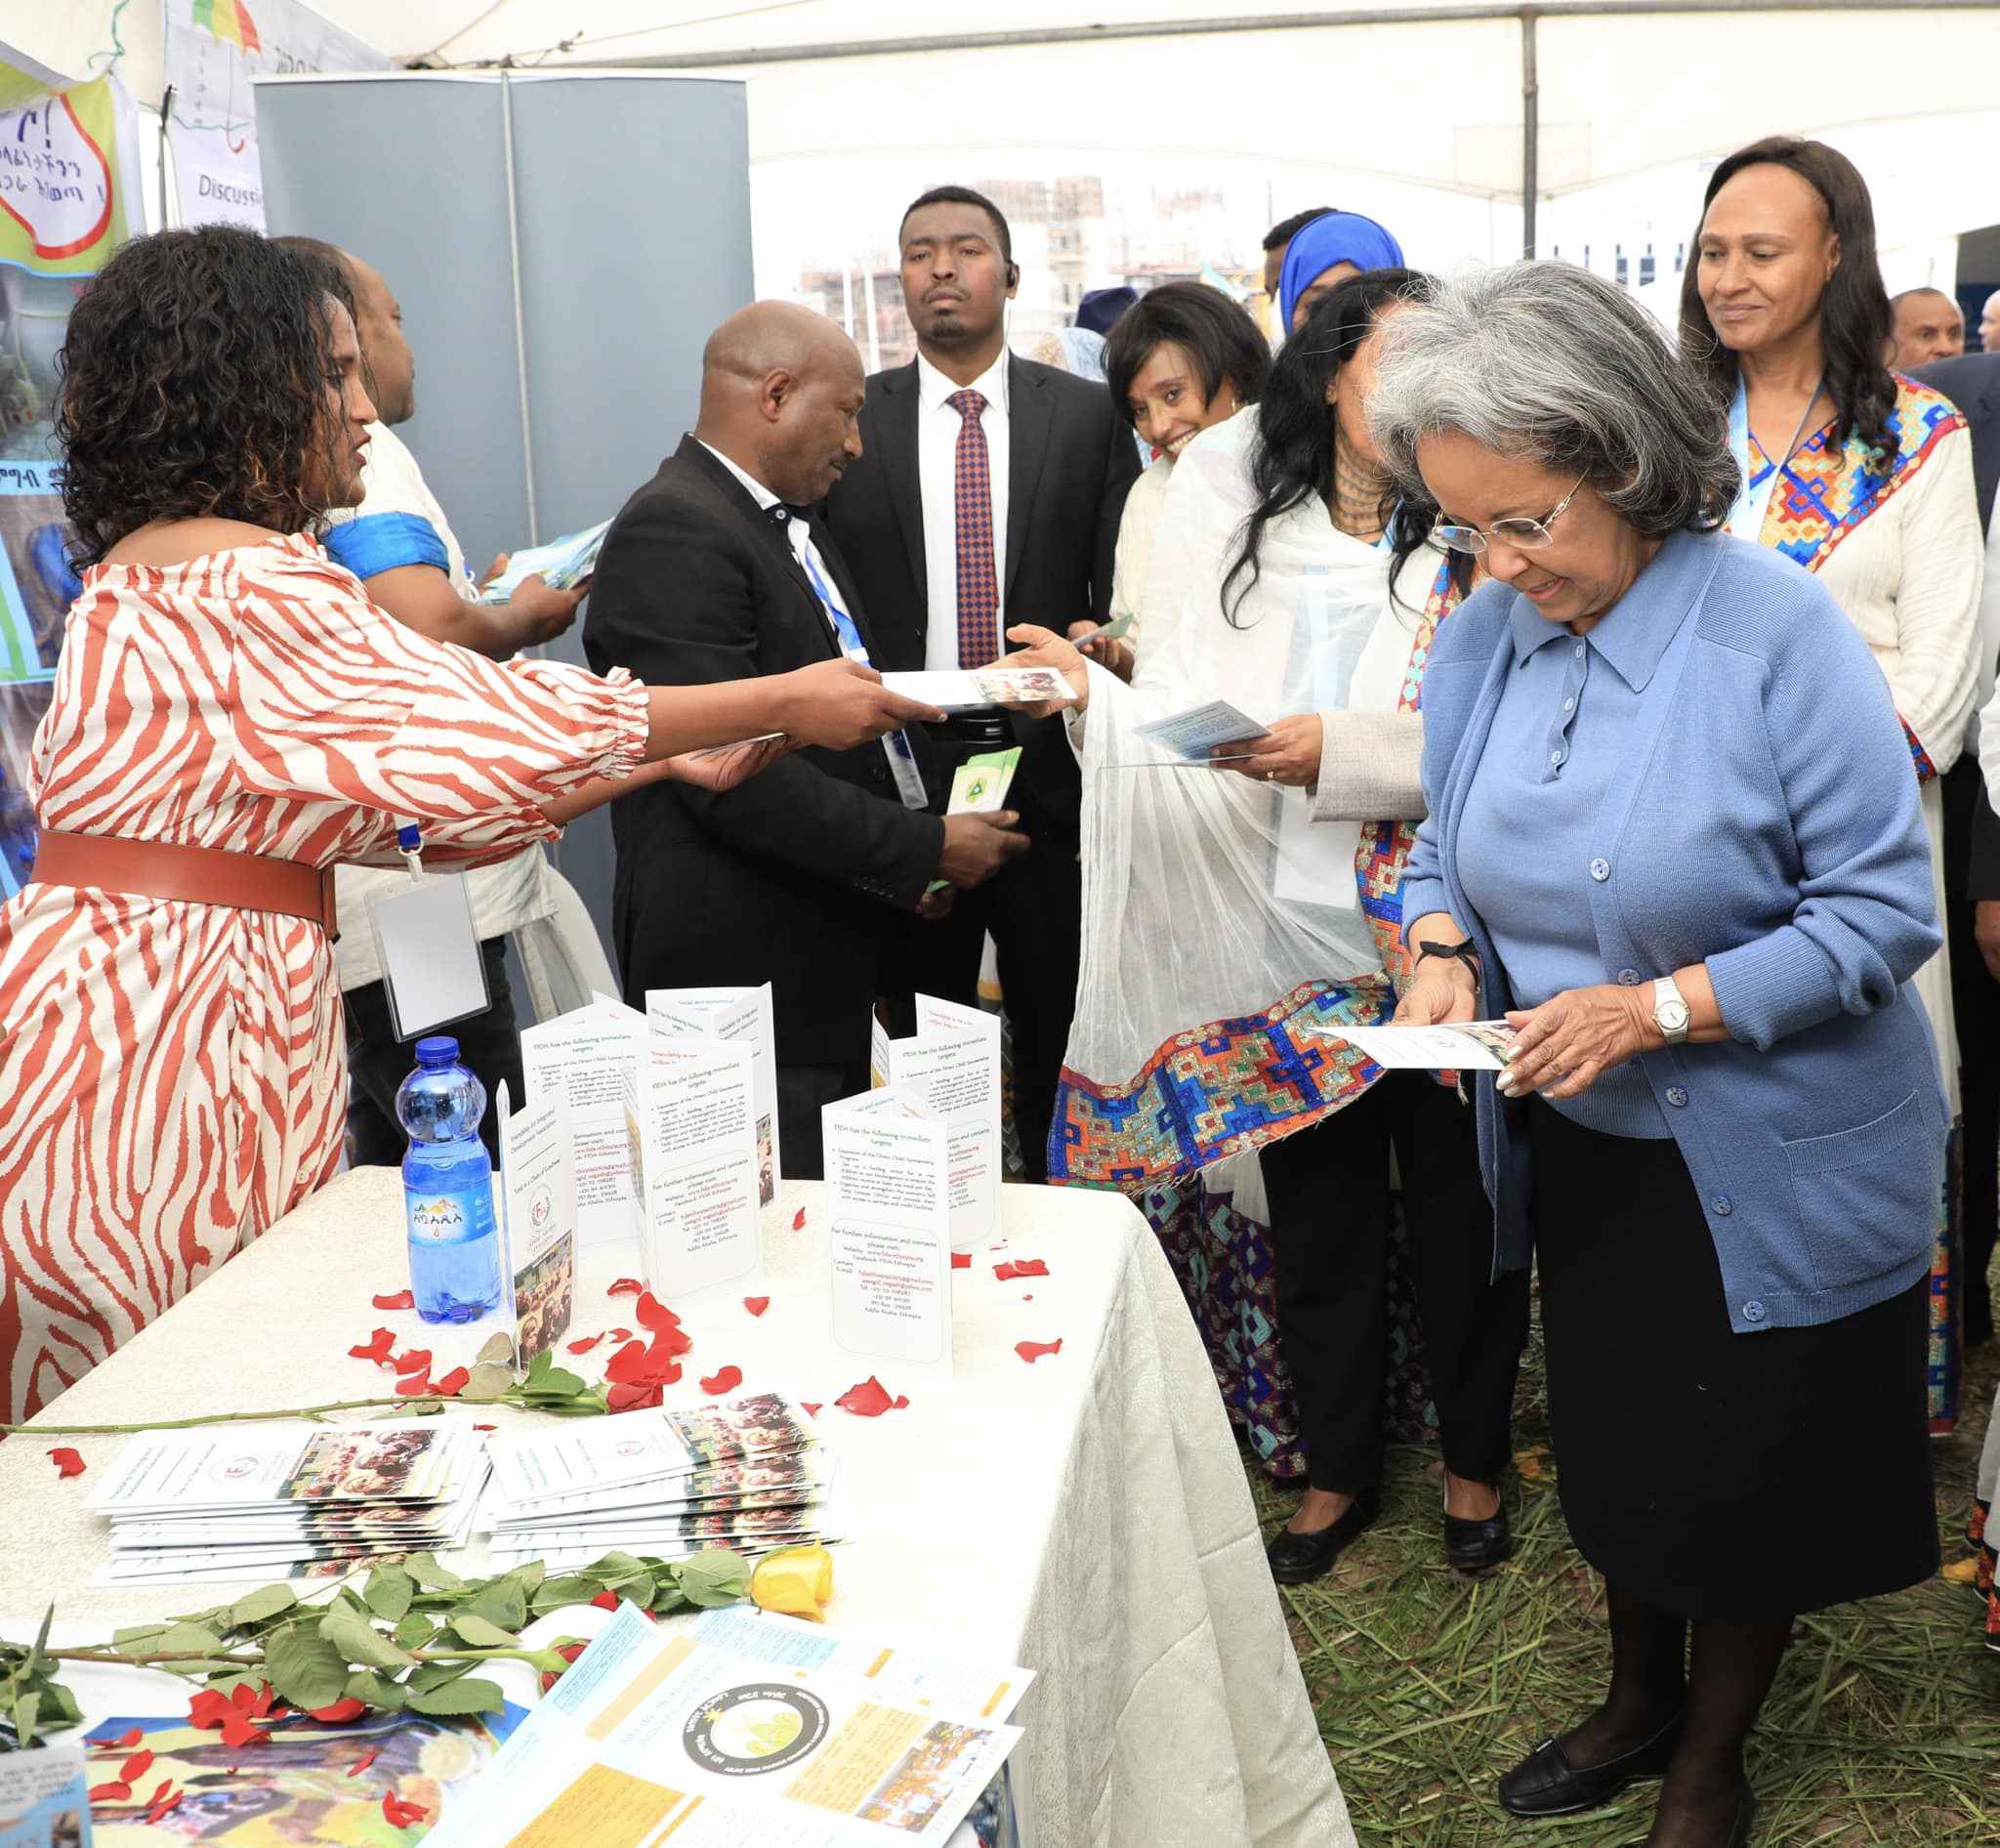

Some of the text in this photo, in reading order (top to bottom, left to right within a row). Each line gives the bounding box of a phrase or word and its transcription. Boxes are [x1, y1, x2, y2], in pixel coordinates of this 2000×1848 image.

[198, 173, 262, 207] Discussi
[572, 1035, 600, 1045] following
[938, 1042, 961, 1053] following
[652, 1081, 667, 1090] FIDA
[688, 1070, 712, 1080] following
[850, 1125, 859, 1134] has
[871, 1128, 898, 1140] following
[663, 1178, 684, 1189] further
[684, 1168, 715, 1182] information
[716, 1163, 727, 1173] and
[842, 1227, 862, 1238] further
[863, 1232, 897, 1242] information
[899, 1237, 911, 1245] and
[912, 1239, 937, 1248] contacts
[867, 1241, 885, 1250] please
